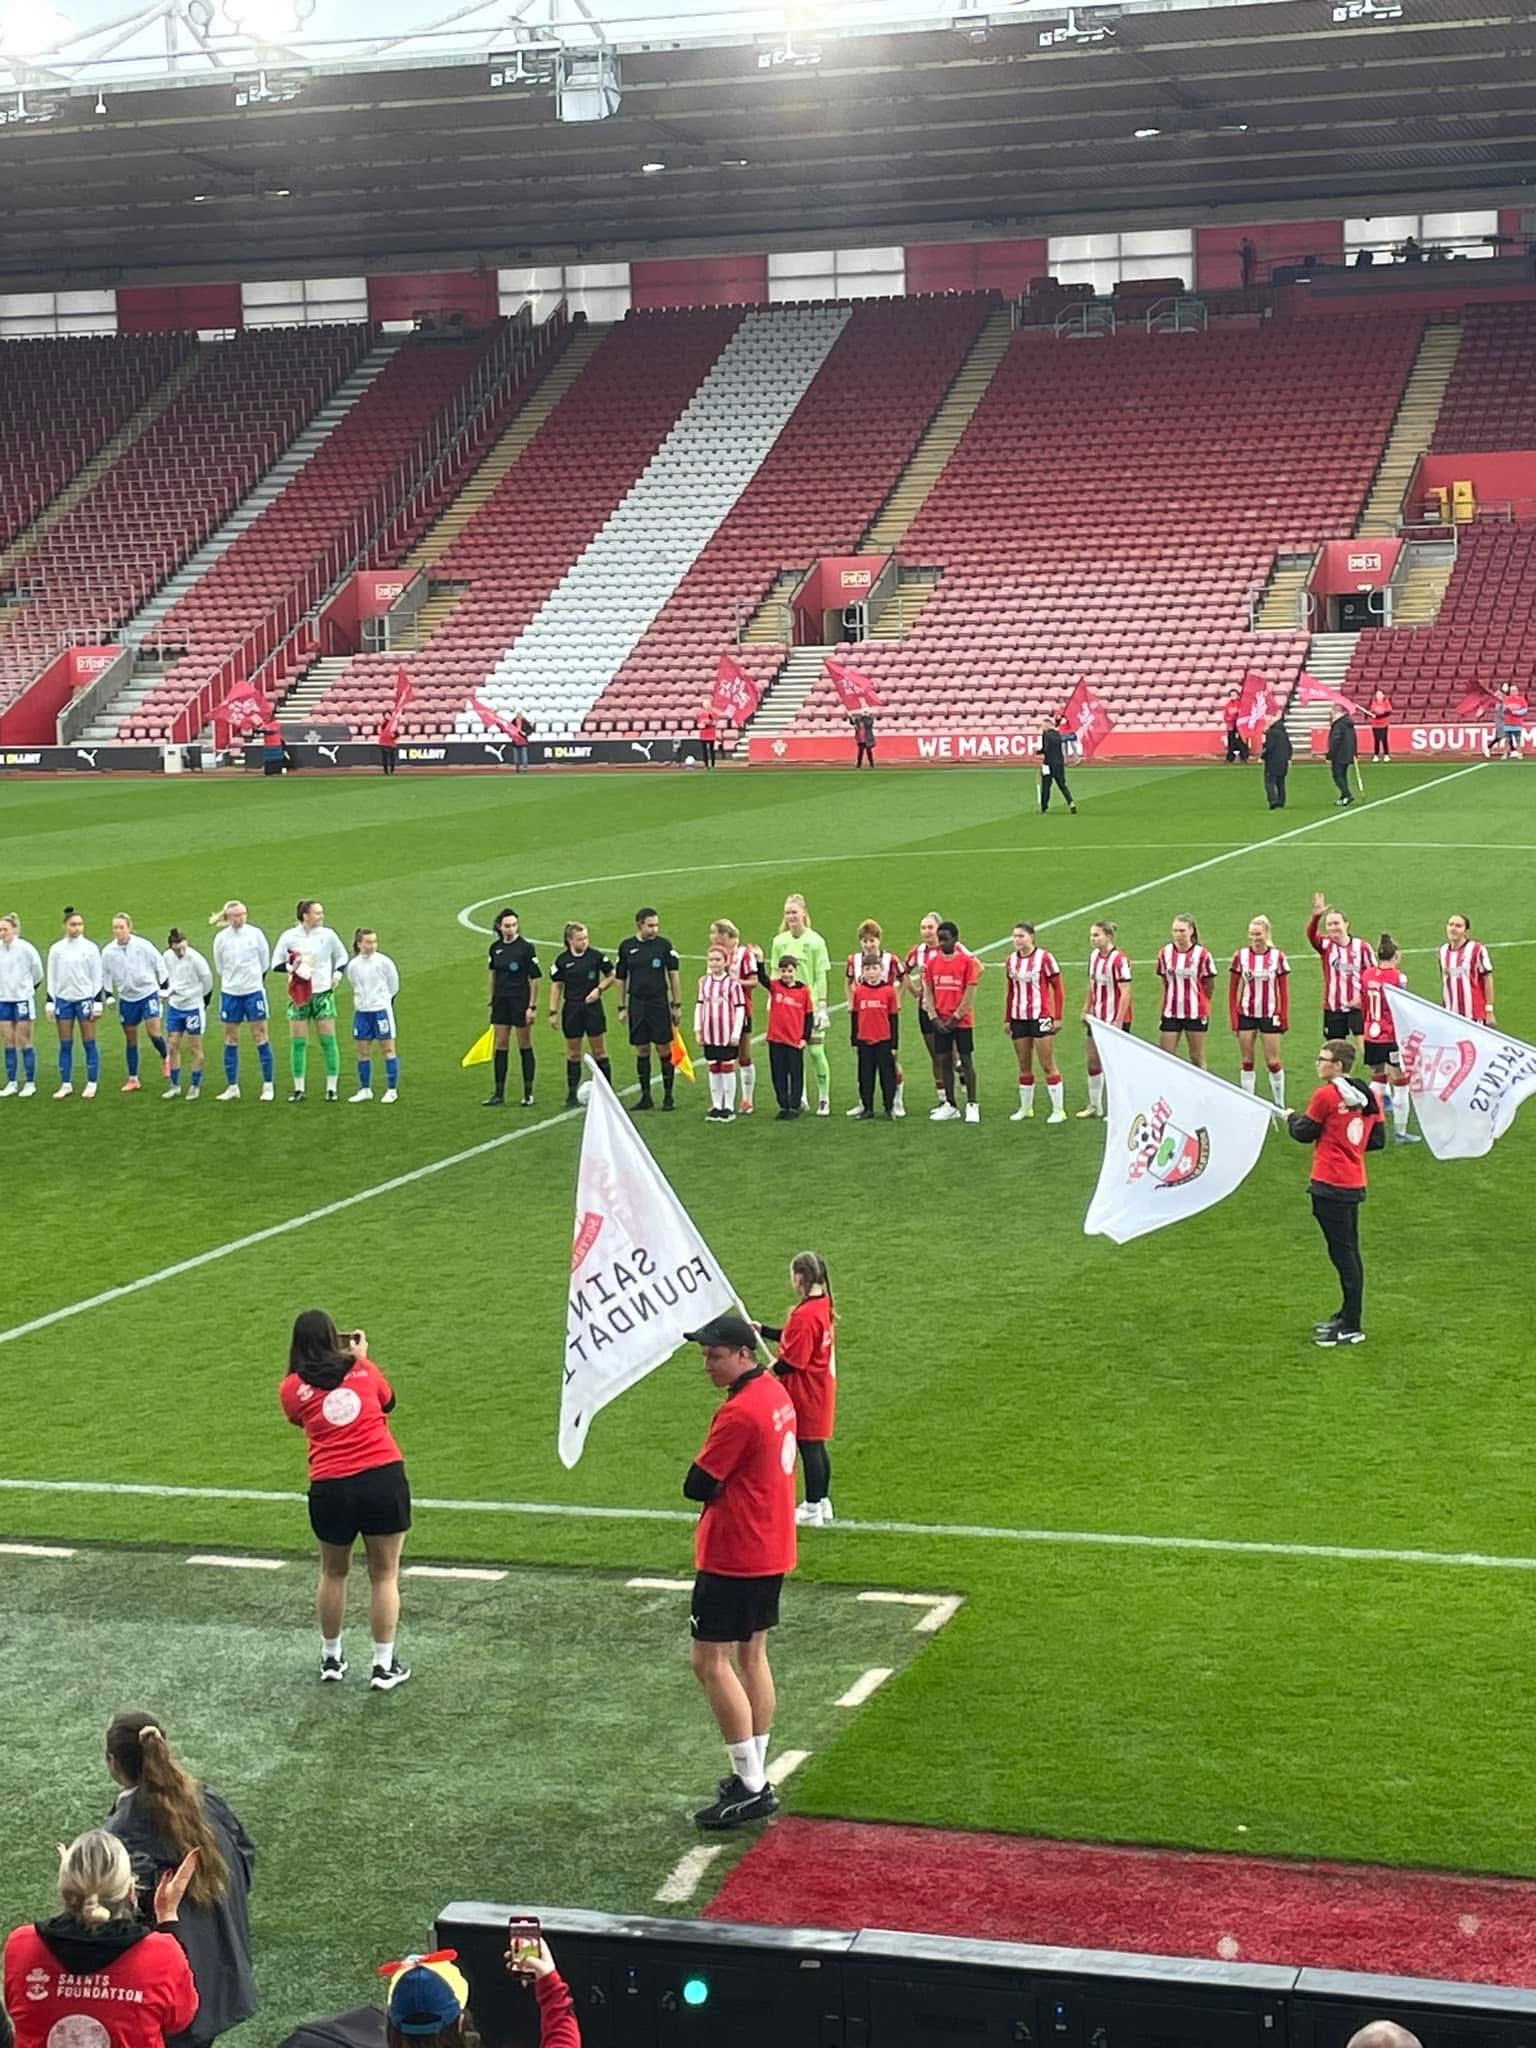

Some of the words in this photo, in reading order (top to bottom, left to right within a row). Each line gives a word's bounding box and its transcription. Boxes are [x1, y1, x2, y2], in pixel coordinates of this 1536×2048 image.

[918, 736, 952, 757] WE
[958, 736, 1043, 756] MARCH
[1411, 727, 1536, 750] SOUTHM
[58, 1973, 111, 1986] SAINTS
[56, 1986, 144, 2003] FOUNDATION
